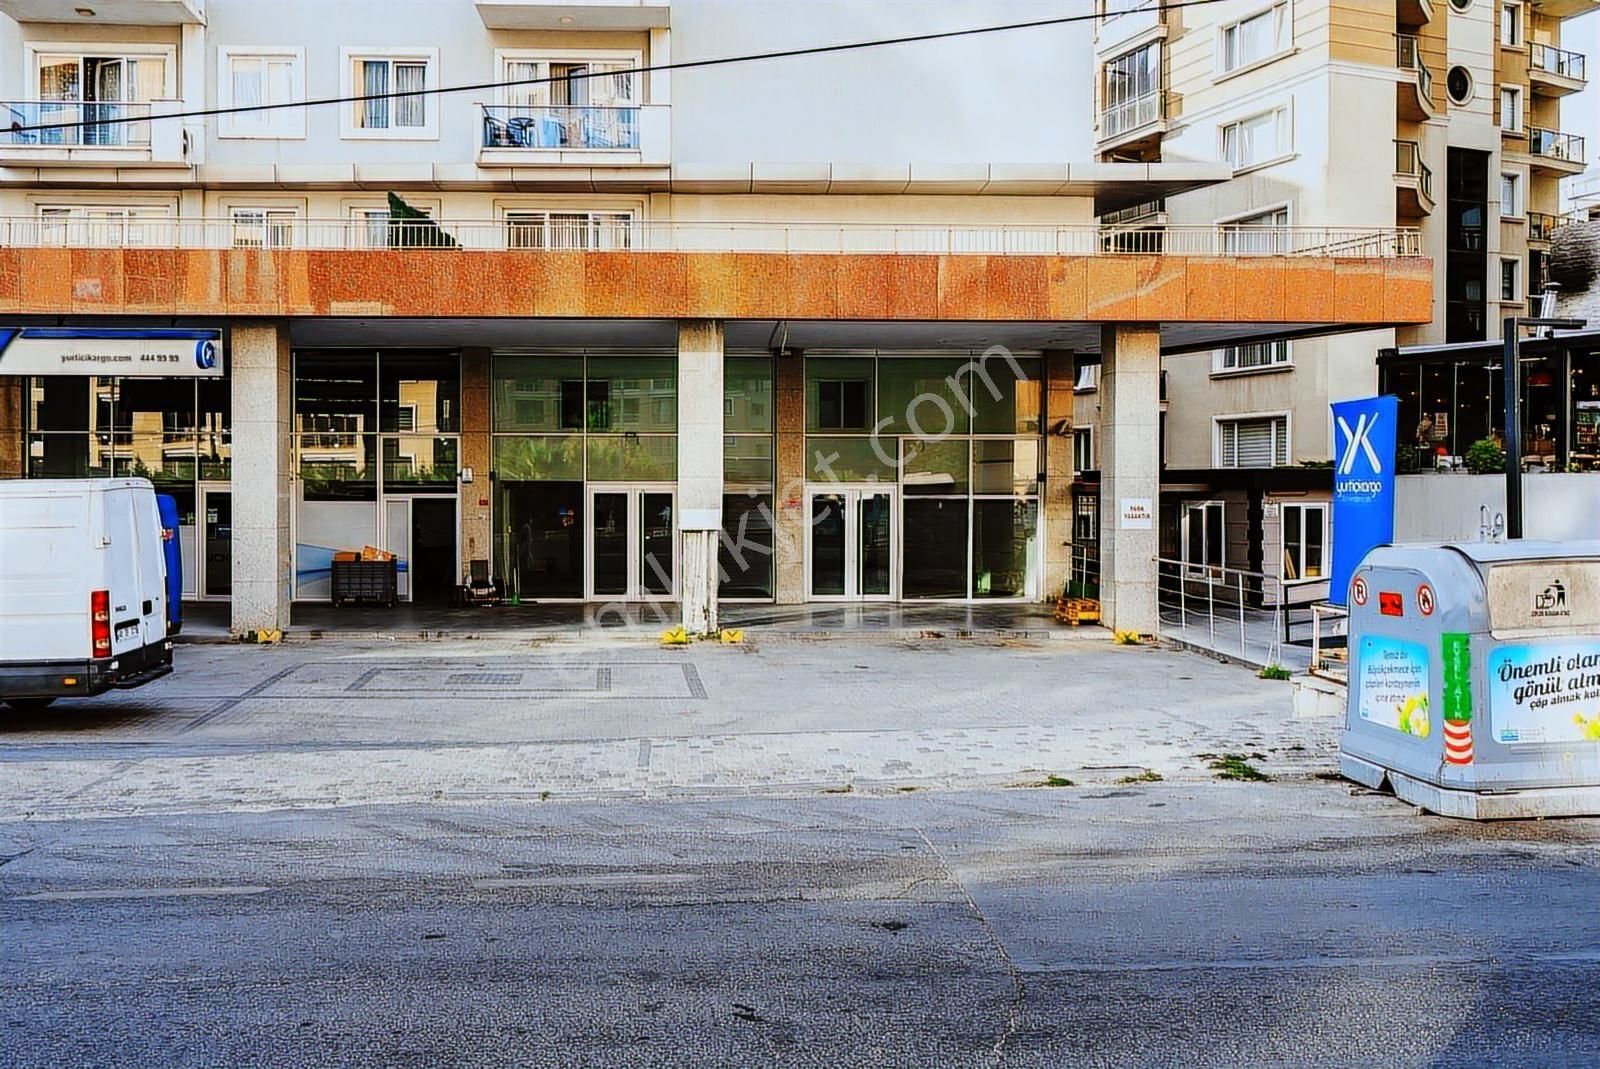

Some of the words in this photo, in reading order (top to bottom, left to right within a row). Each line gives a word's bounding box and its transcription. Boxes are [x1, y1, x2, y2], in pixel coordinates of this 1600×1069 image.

[140, 354, 156, 362] 444
[1498, 658, 1562, 682] Önemli
[1513, 676, 1563, 705] gönül
